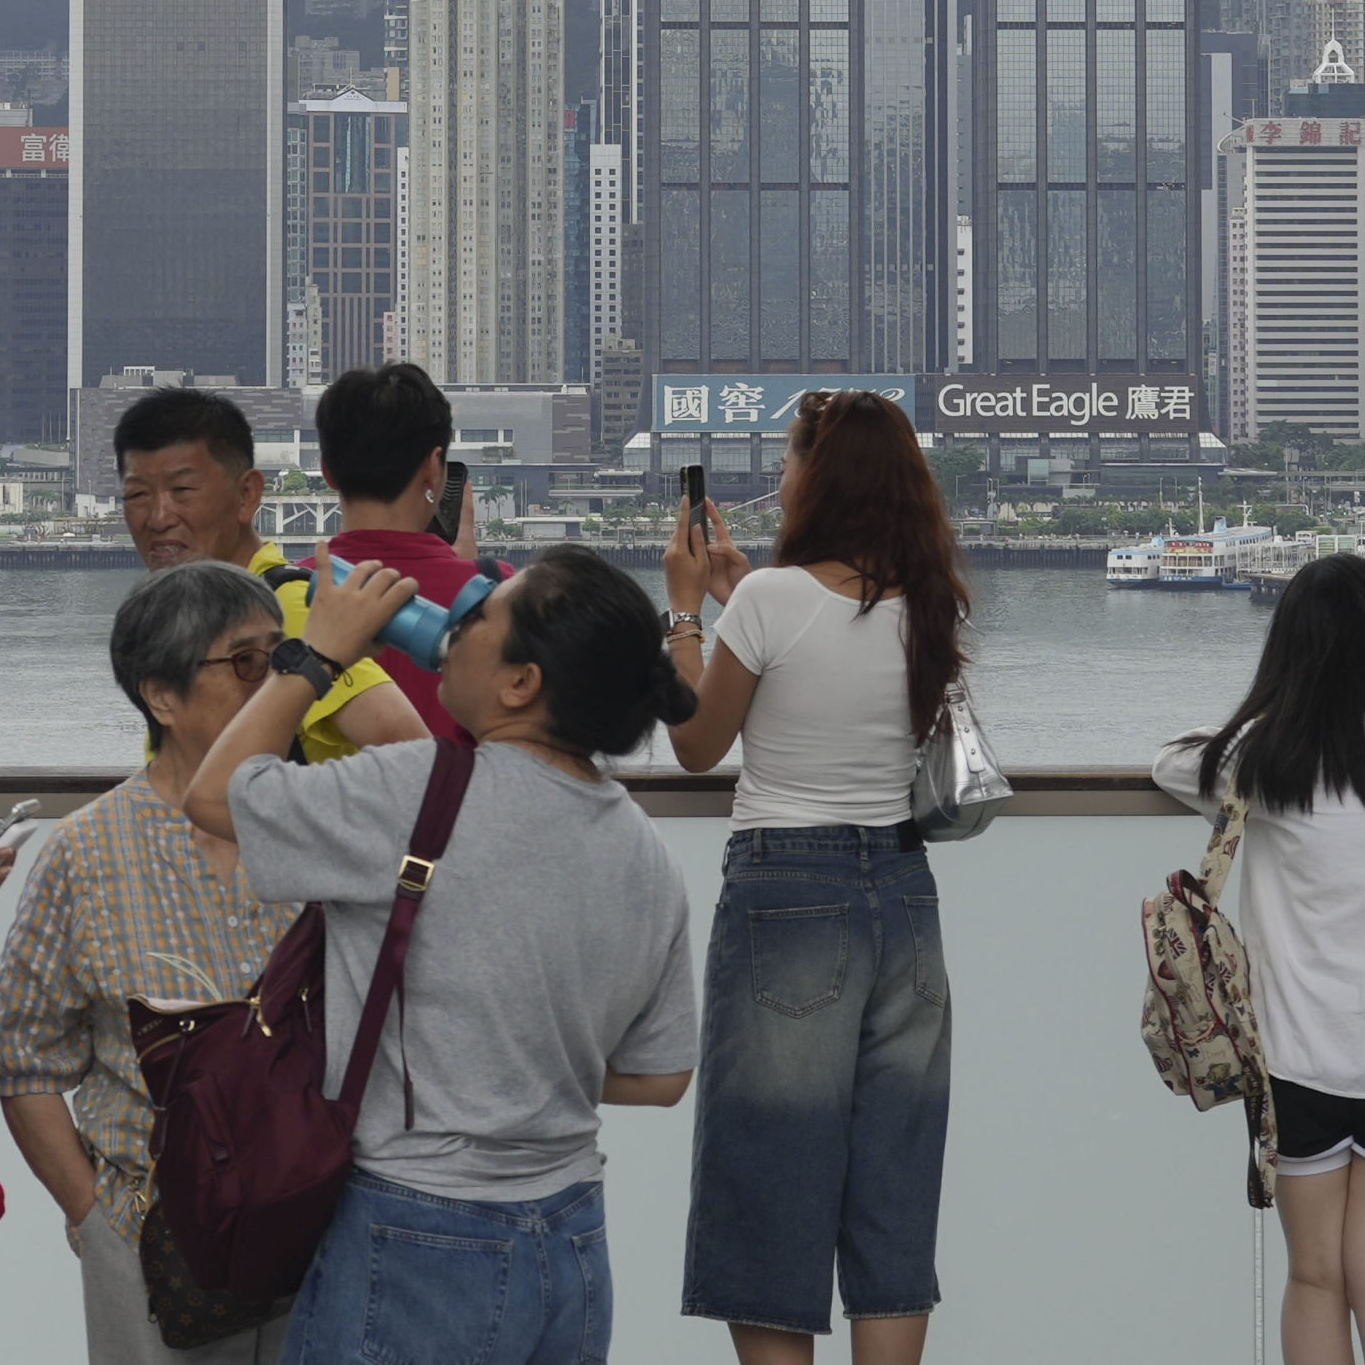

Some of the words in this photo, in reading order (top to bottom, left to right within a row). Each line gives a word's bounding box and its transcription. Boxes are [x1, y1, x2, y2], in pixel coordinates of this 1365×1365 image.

[1259, 120, 1362, 146] 李錦記
[663, 381, 766, 426] 國窖
[938, 383, 1027, 417] Great
[1031, 382, 1119, 426] Eagle
[1125, 384, 1196, 421] 鷹君
